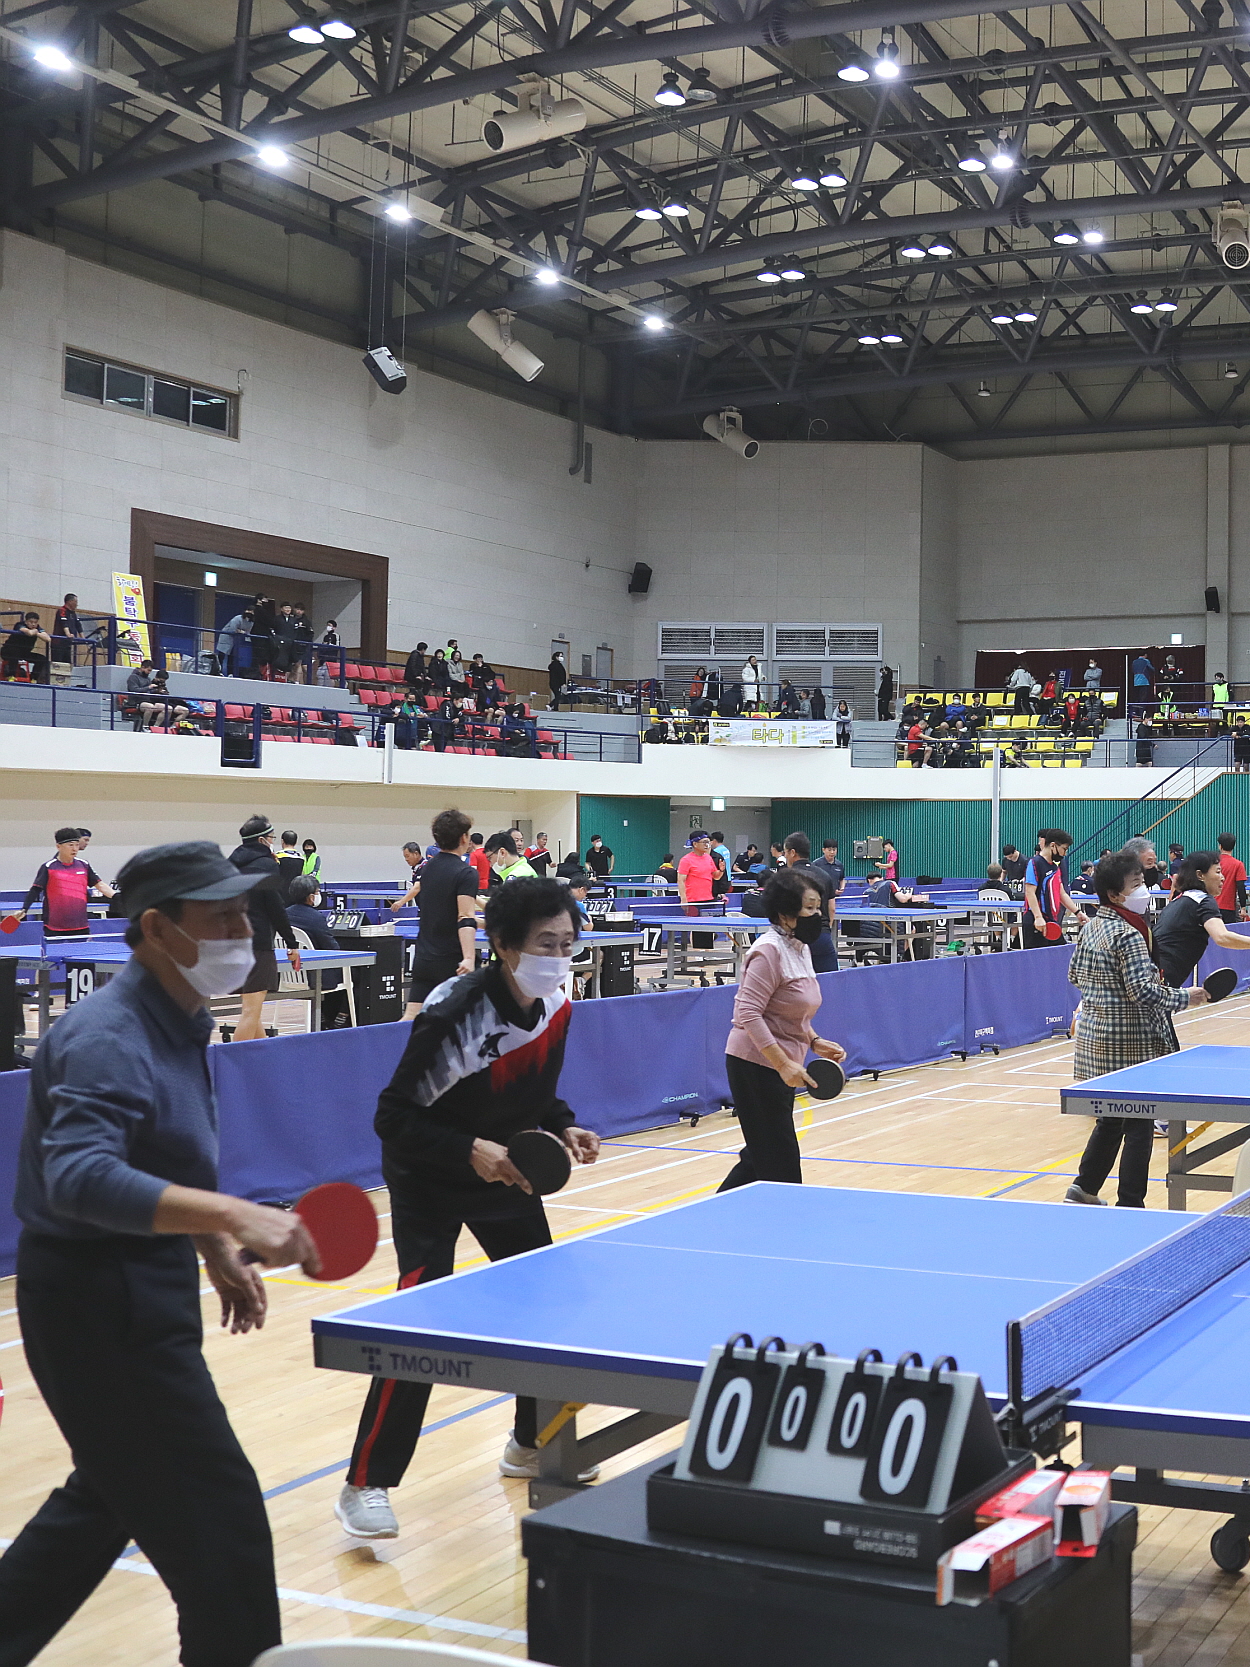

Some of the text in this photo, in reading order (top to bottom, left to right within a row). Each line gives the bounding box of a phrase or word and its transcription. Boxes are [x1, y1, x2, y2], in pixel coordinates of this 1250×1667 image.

[641, 928, 661, 951] 17
[67, 968, 94, 1002] 19
[669, 1092, 699, 1102] CHAMPION
[1107, 1103, 1157, 1114] TMOUNT
[389, 1353, 473, 1378] TMOUNT
[705, 1376, 927, 1495] 0 0 0 0
